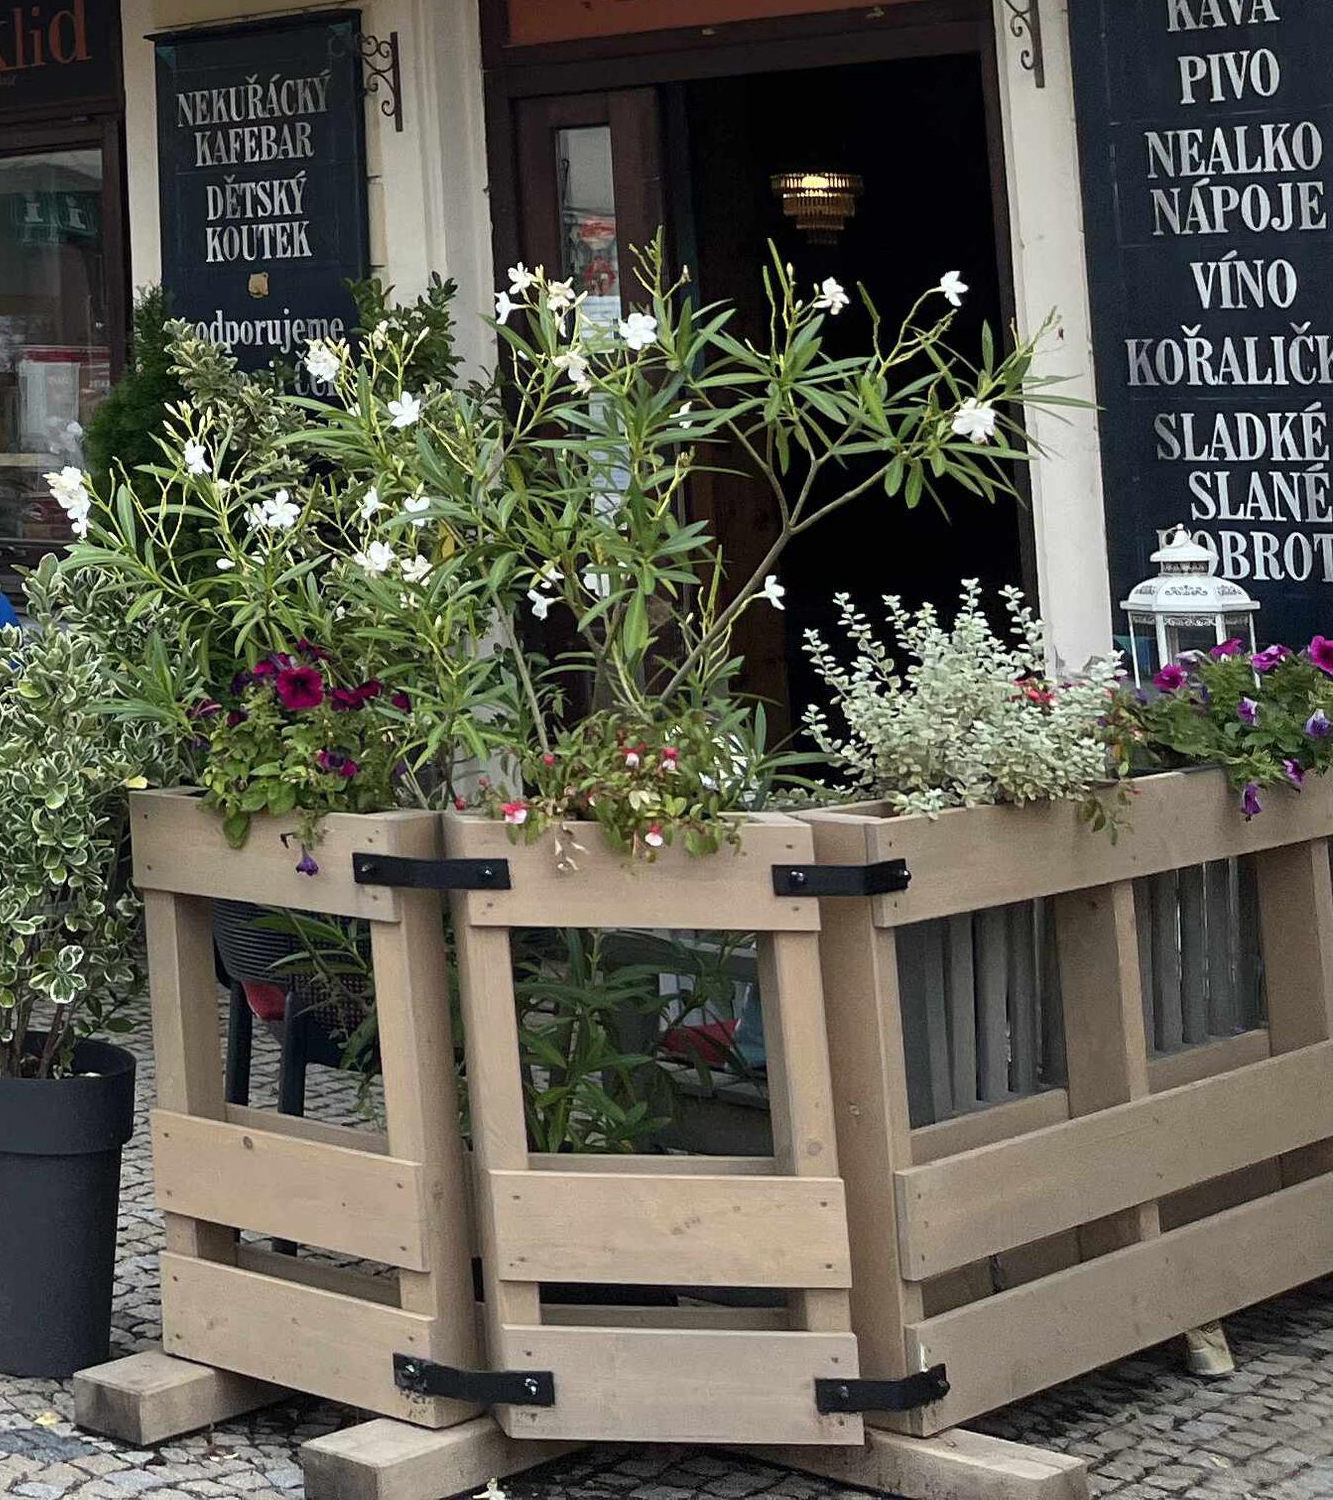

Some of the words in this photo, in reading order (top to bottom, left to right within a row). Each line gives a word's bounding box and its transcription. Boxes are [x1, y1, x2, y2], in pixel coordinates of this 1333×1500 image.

[176, 69, 331, 128] NEKUŘÁCKÝ
[1177, 48, 1280, 105] PIVO
[194, 122, 315, 167] KAFEBAR
[1144, 121, 1323, 179] NEALKO
[206, 170, 307, 220] DĚTSKÝ
[1150, 178, 1326, 236] NÁPOJE
[205, 220, 312, 263] KOUTEK
[1189, 250, 1297, 309] VÍNO
[194, 307, 344, 354] odporujeme
[1153, 401, 1330, 461] SLADKÉ
[1188, 462, 1333, 523] SLANÉ
[1156, 529, 1333, 582] OBROT
